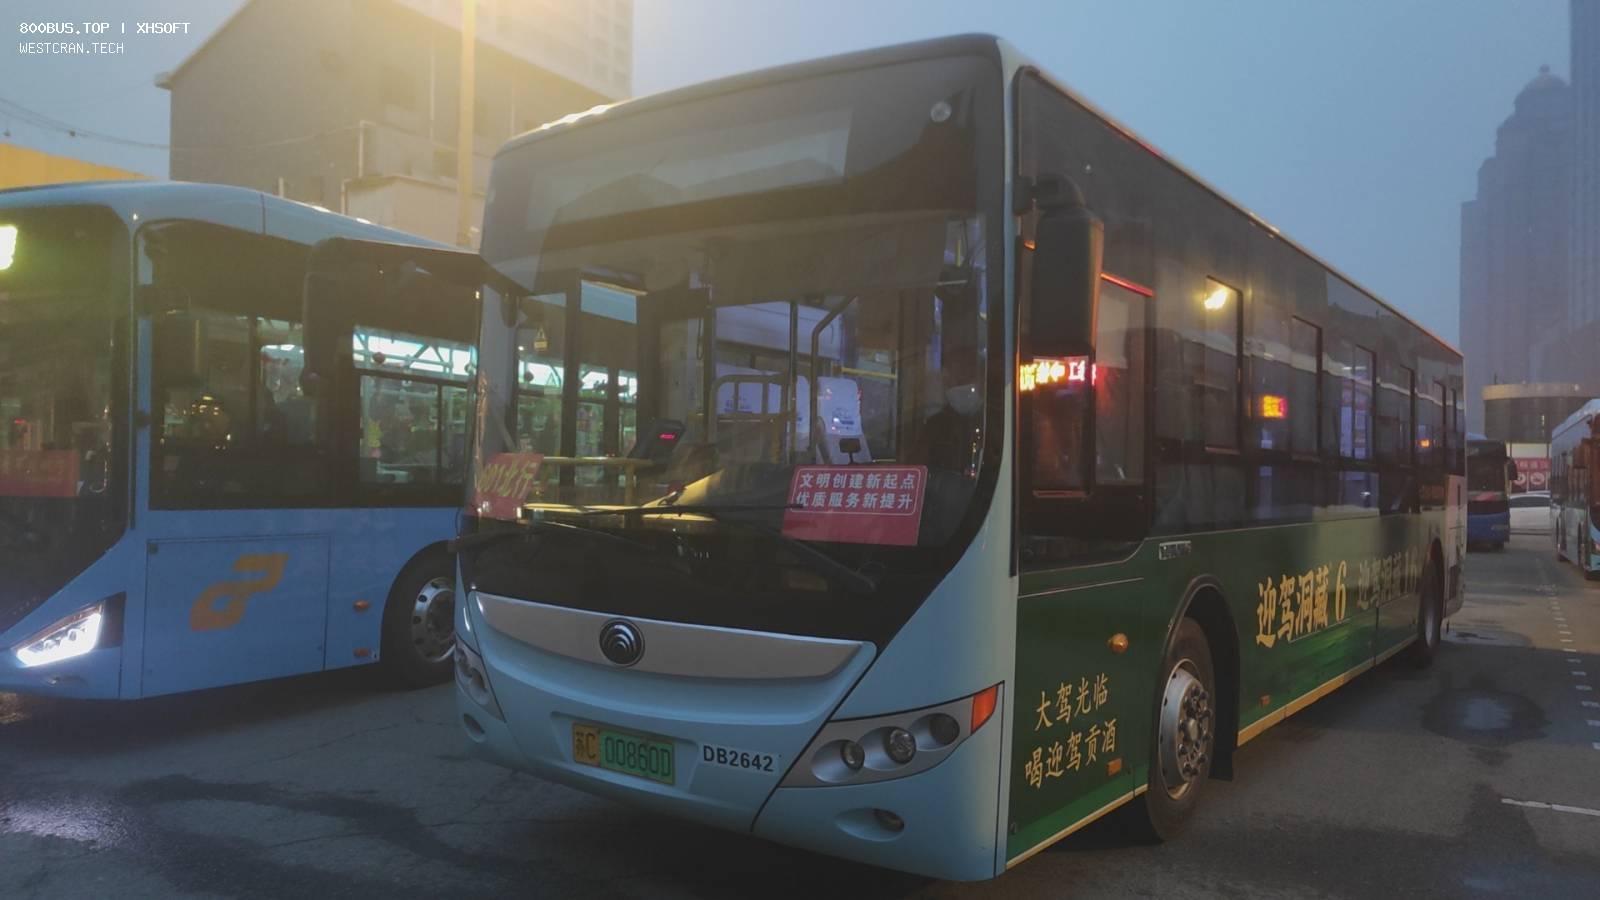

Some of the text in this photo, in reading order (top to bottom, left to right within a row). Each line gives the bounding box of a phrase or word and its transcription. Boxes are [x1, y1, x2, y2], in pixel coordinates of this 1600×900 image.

[795, 491, 914, 509] 优质服务新提升
[799, 472, 916, 489] 文明创建新起点
[1256, 564, 1329, 649] 迎驾洞藏
[1335, 559, 1348, 622] 6
[1034, 672, 1109, 732] 大驾光临
[702, 745, 774, 773] DB2642
[1025, 718, 1117, 789] 喝迎驾贡酒
